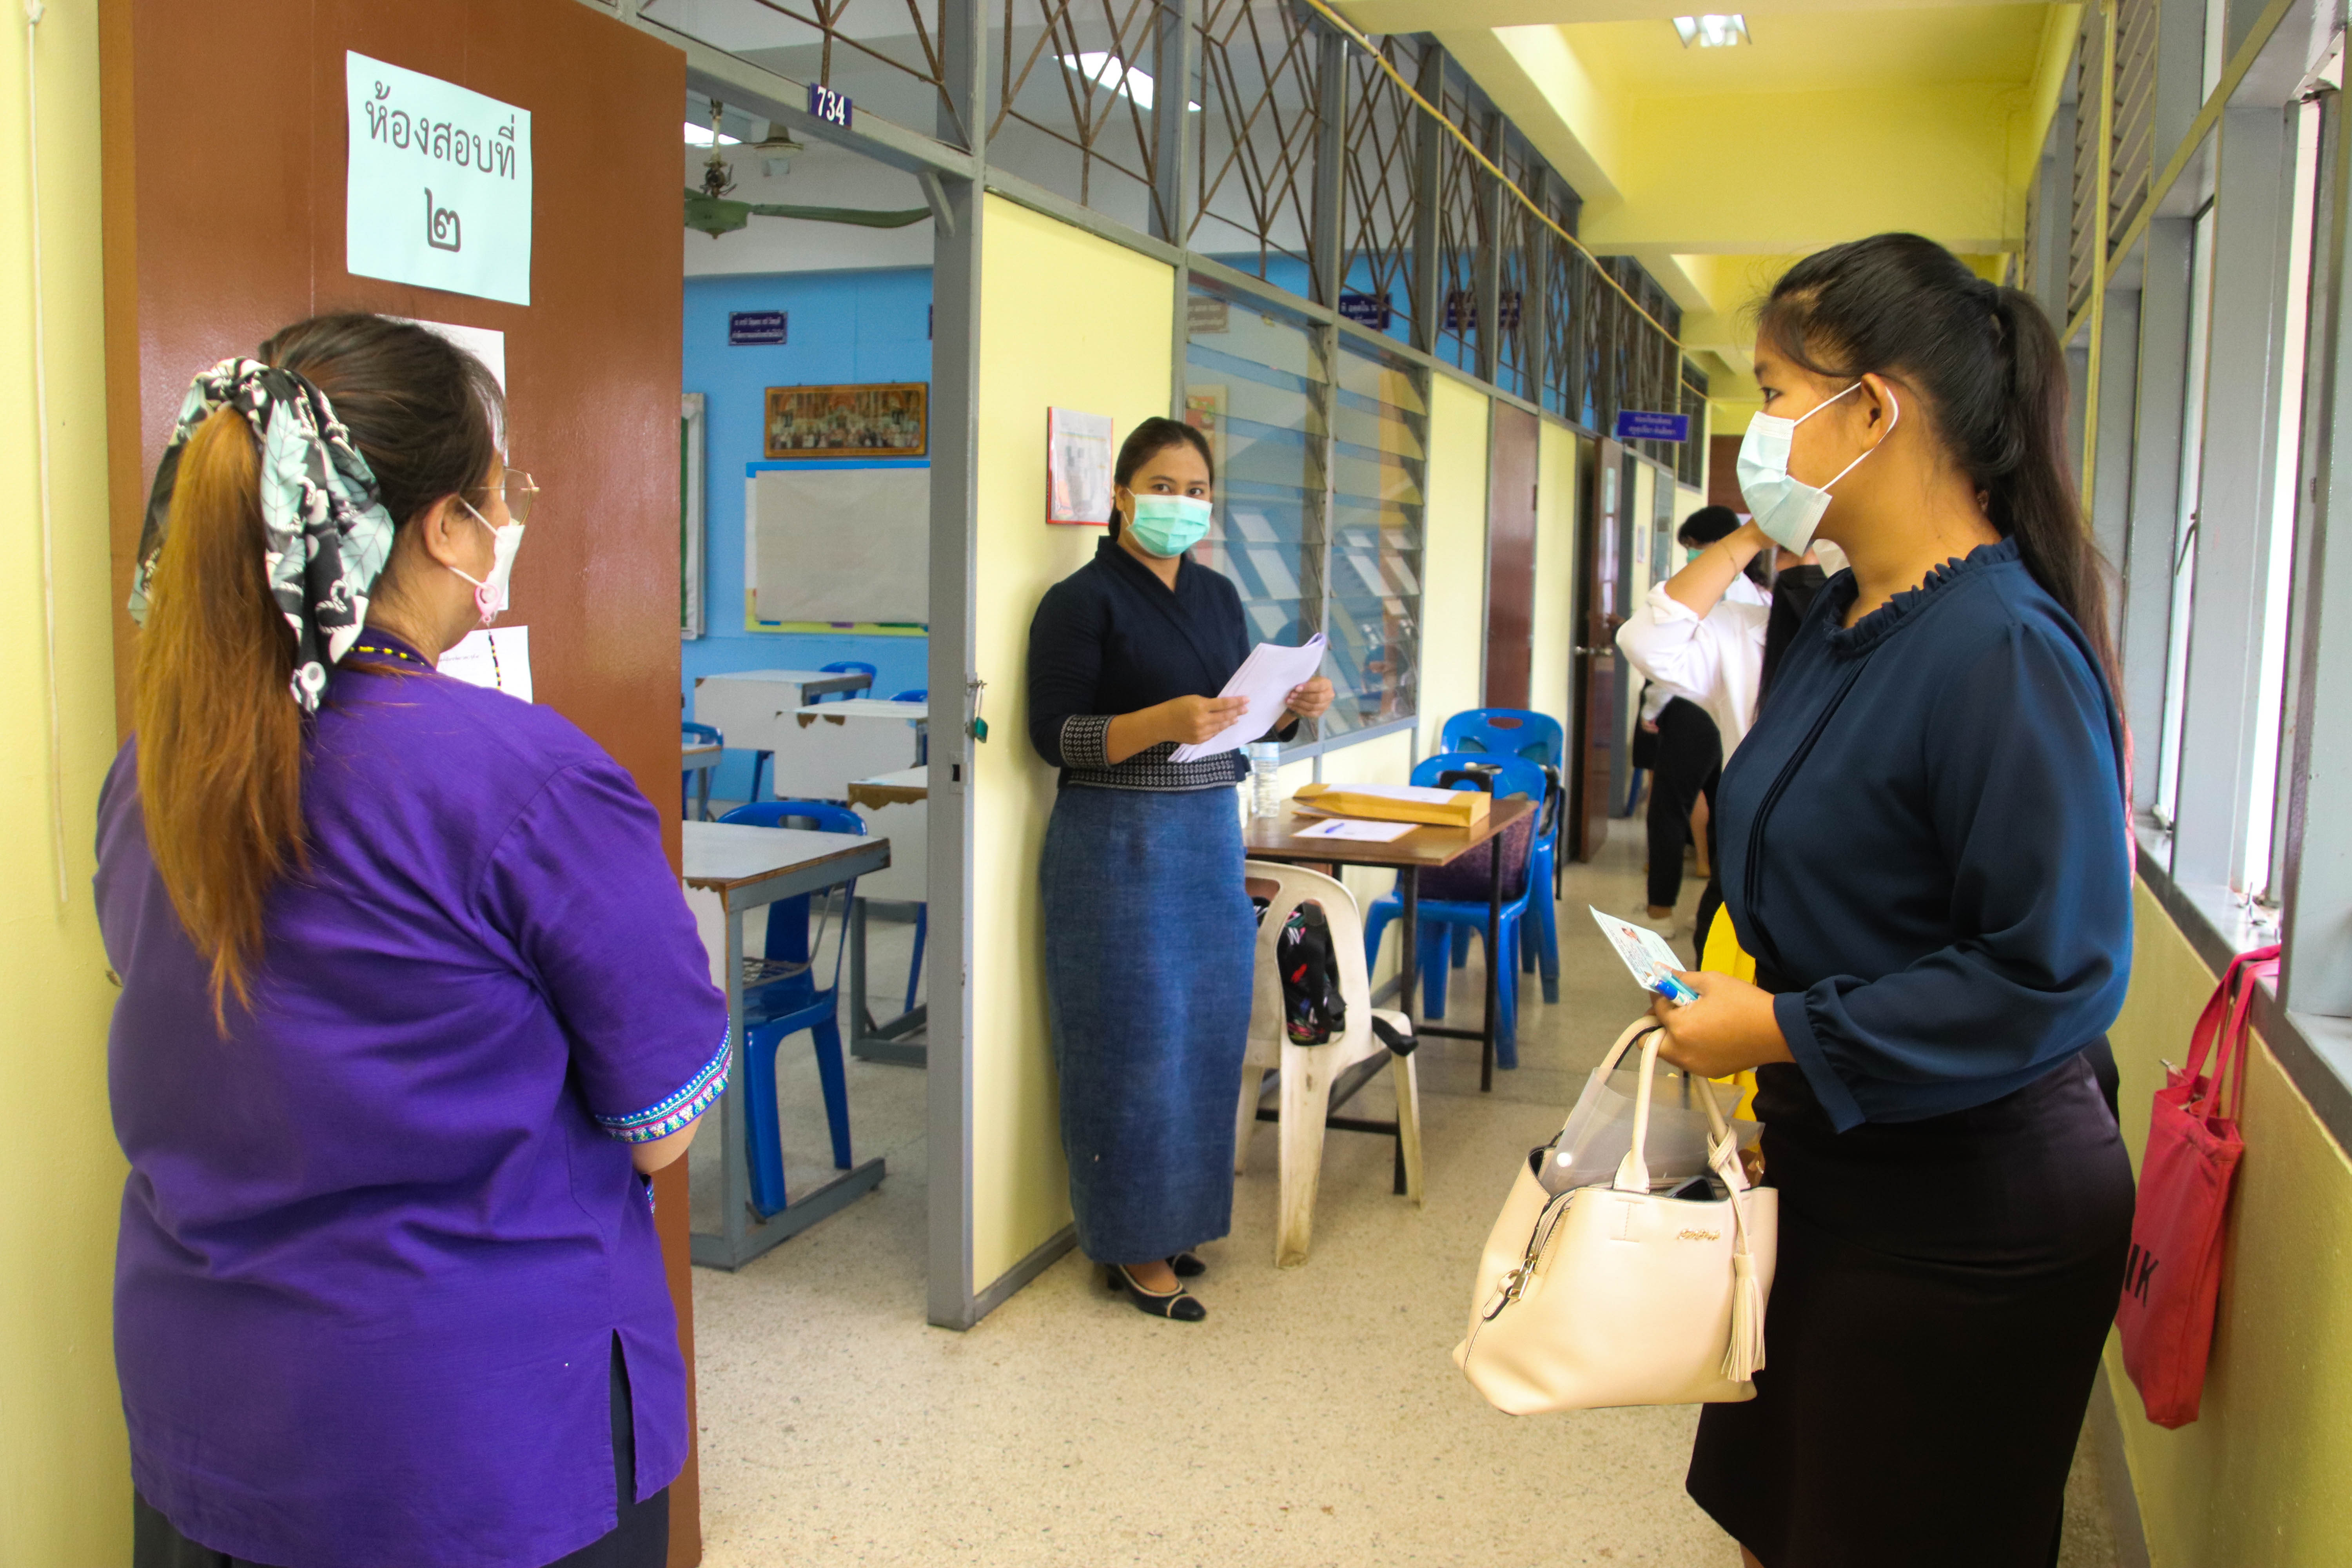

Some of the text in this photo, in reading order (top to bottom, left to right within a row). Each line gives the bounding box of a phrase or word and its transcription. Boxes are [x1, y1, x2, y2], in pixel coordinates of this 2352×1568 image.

[365, 80, 515, 180] ห้องสอบที่
[817, 86, 845, 125] 734
[424, 187, 461, 253] ๒
